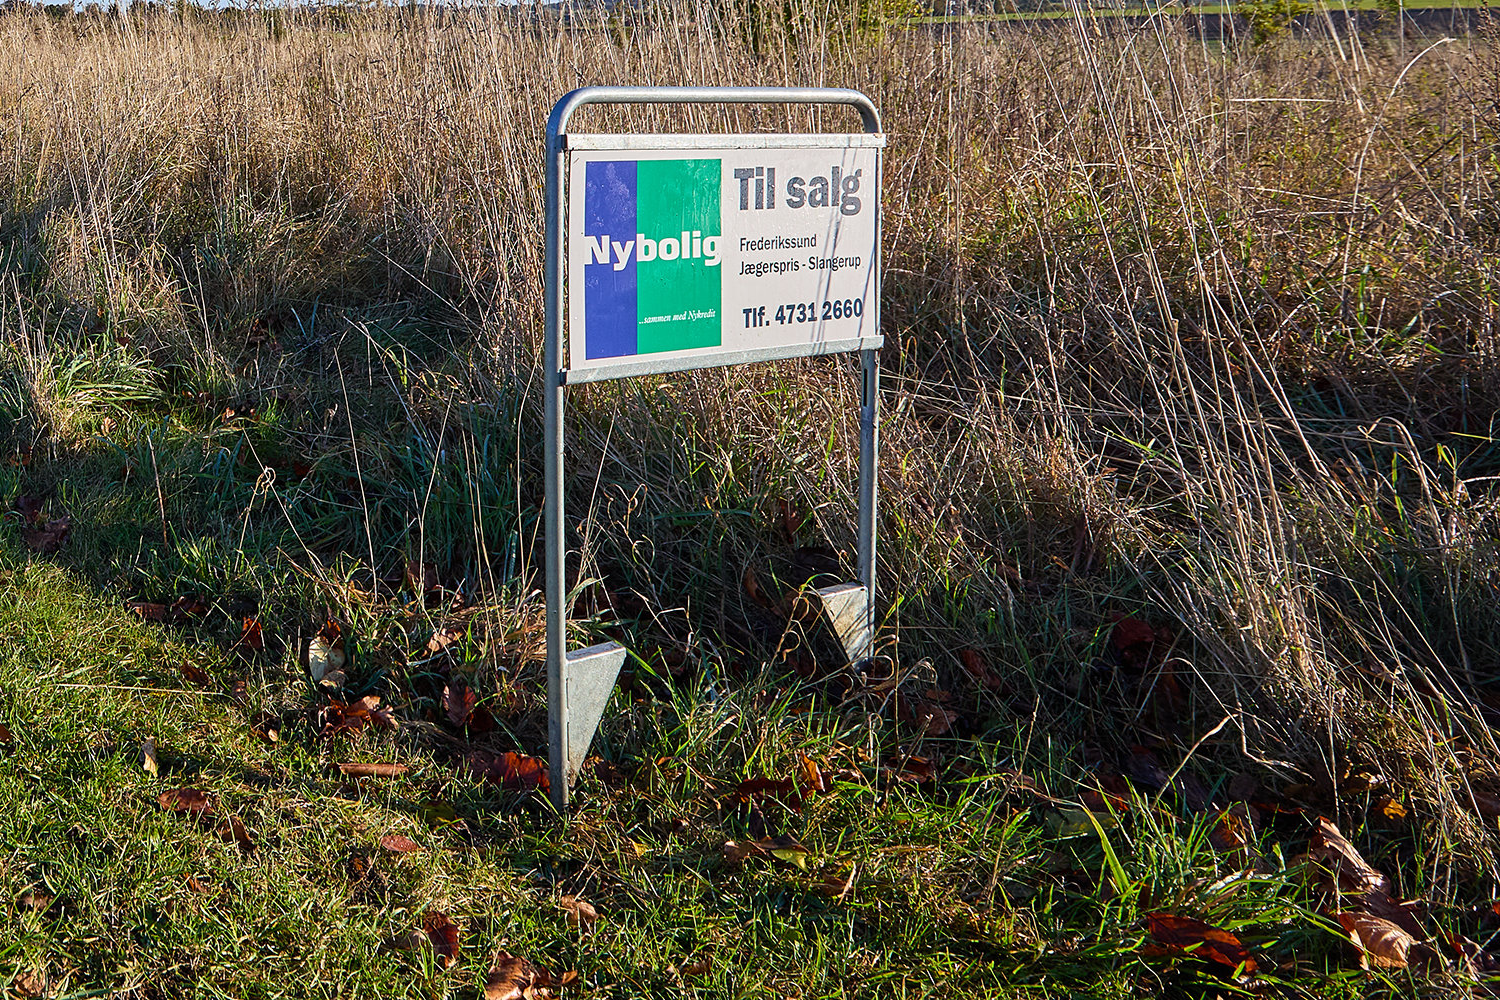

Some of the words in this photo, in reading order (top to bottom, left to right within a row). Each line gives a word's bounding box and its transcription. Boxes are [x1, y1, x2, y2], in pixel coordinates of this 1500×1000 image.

[734, 167, 775, 210] Til
[786, 166, 861, 216] salg
[584, 231, 722, 271] Nybolig
[740, 236, 816, 251] Frederikssund
[739, 260, 799, 276] Jægerspris
[808, 256, 861, 272] Slangerup
[672, 312, 687, 321] med
[688, 310, 716, 321] Nykredit
[743, 306, 770, 328] Tlf.
[775, 302, 817, 324] 4731
[822, 299, 862, 321] 2660
